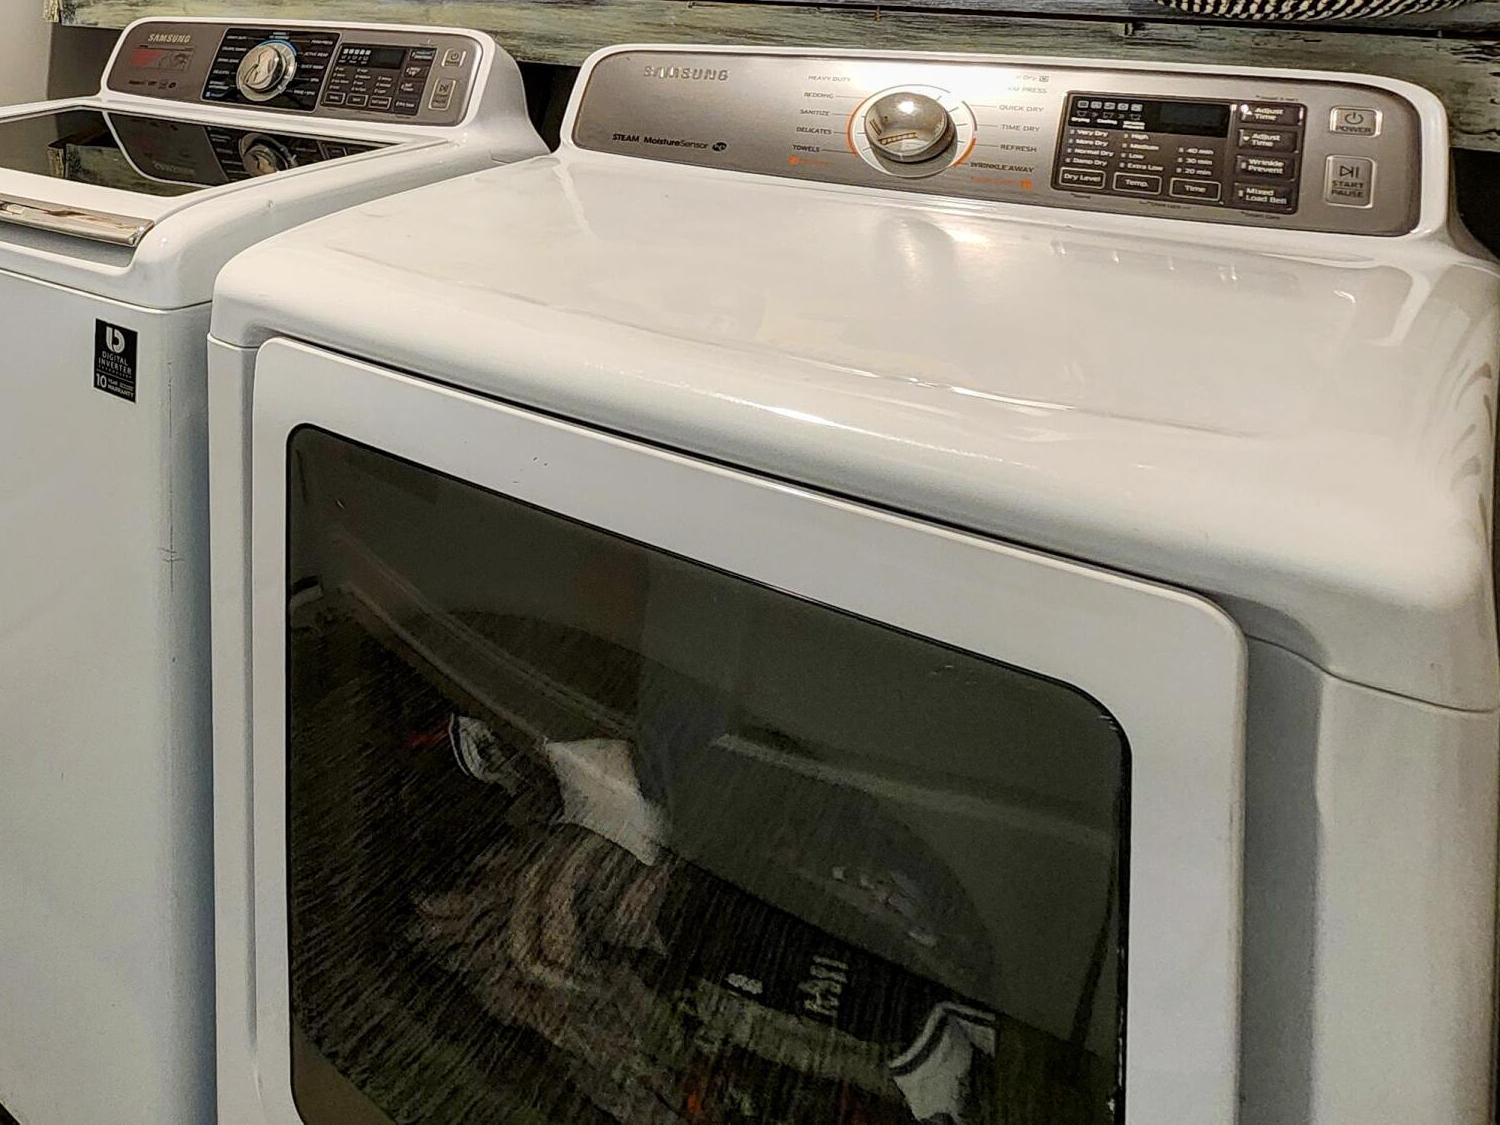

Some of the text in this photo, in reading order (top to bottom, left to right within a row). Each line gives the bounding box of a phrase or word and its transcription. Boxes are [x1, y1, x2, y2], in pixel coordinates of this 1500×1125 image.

[147, 33, 191, 43] SAMSUNG
[643, 65, 729, 81] SAMSUNG
[1254, 107, 1284, 115] Adjust
[1254, 113, 1277, 121] Time
[796, 126, 832, 135] DELICATES
[1336, 125, 1372, 133] POWER
[612, 133, 708, 150] STEAM MoistureSensor
[1251, 133, 1281, 141] Adjust
[1252, 139, 1274, 147] Time
[793, 144, 820, 152] TOWELS
[1000, 144, 1037, 152] REFRESH
[1009, 164, 1035, 173] AWAY
[1064, 173, 1101, 182] Dry Level
[1331, 180, 1364, 189] START
[1246, 187, 1274, 196] Mixed
[1331, 188, 1364, 198] PAUSE
[1245, 195, 1268, 203] Load
[102, 350, 128, 366] DIGITAL
[98, 357, 132, 374] INVERTER
[96, 373, 107, 388] 10
